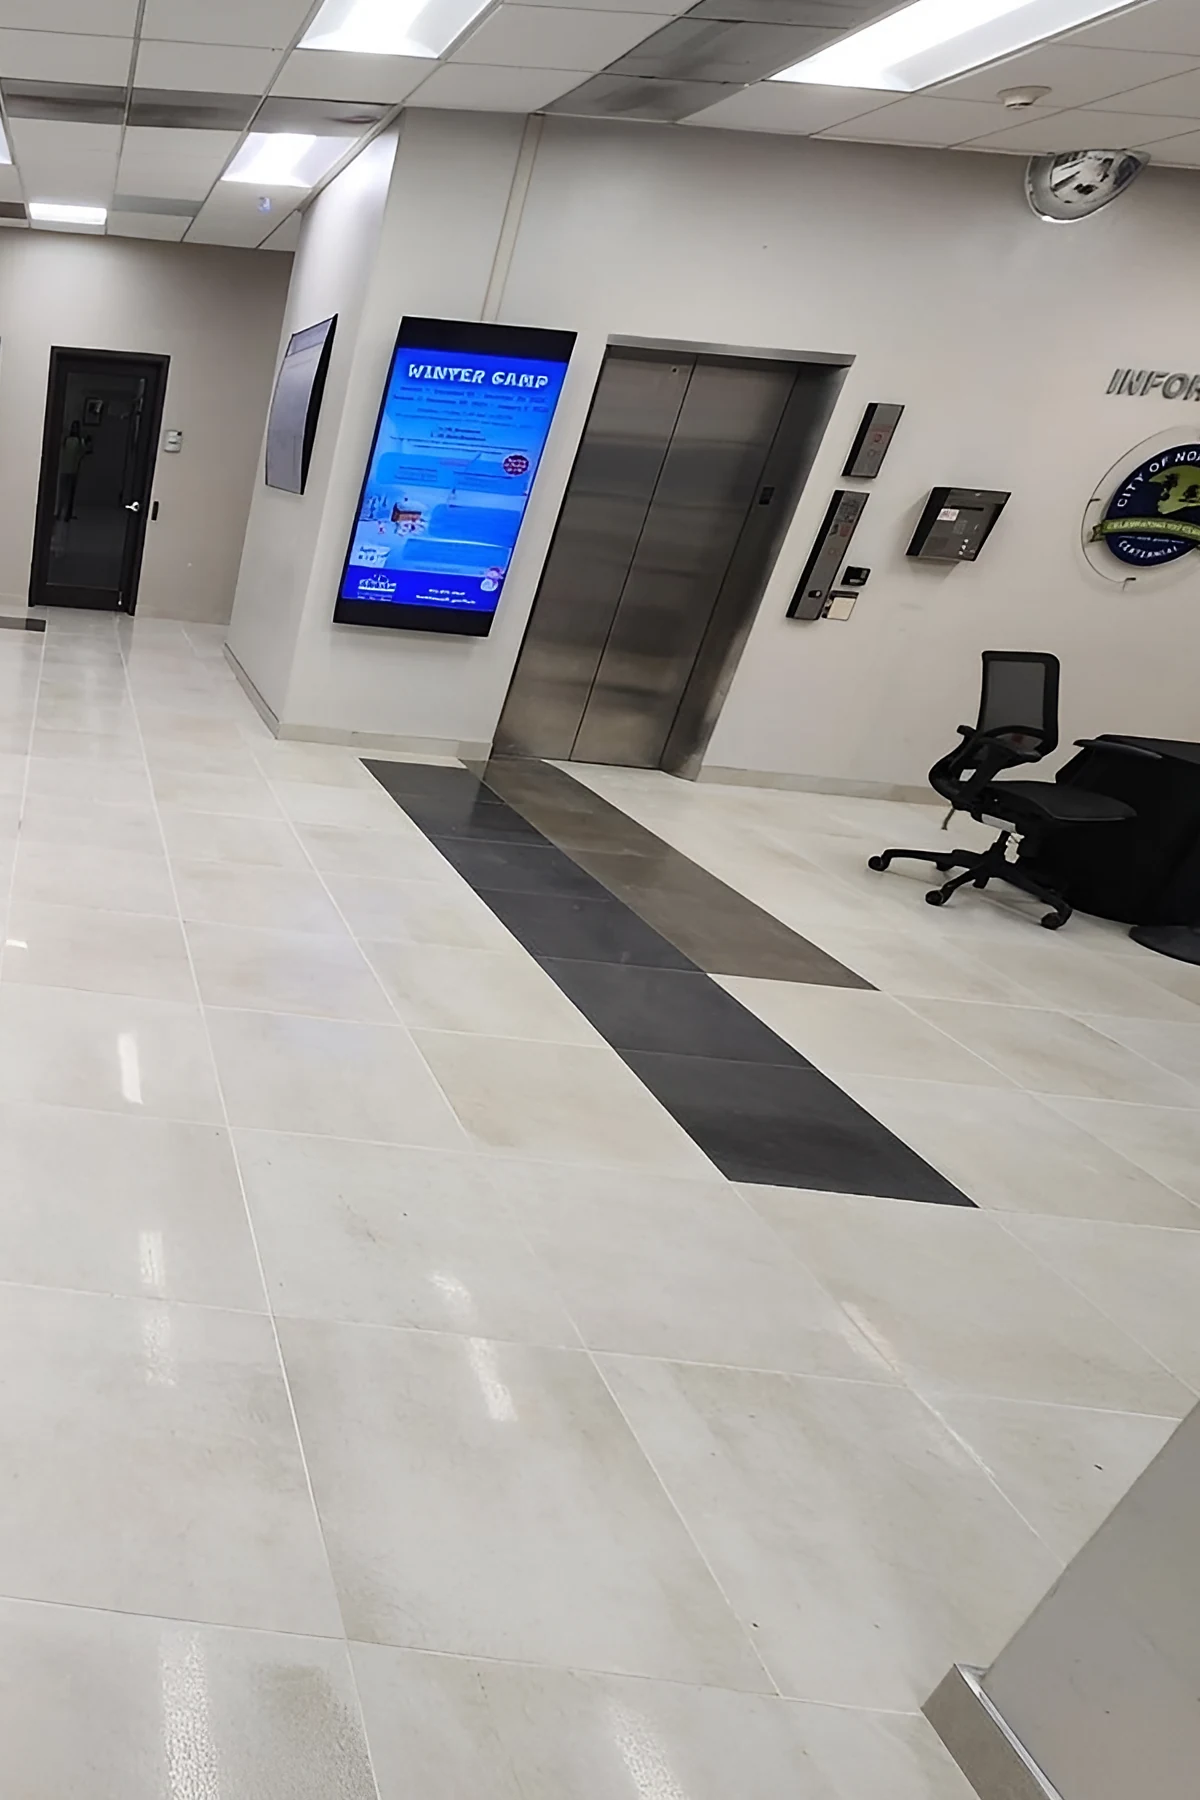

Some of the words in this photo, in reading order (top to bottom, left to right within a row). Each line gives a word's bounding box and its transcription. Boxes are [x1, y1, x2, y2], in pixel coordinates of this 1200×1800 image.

[408, 363, 486, 385] WINTER
[491, 371, 549, 389] CAMP
[1117, 472, 1144, 507] CITY
[1149, 455, 1169, 473] OF
